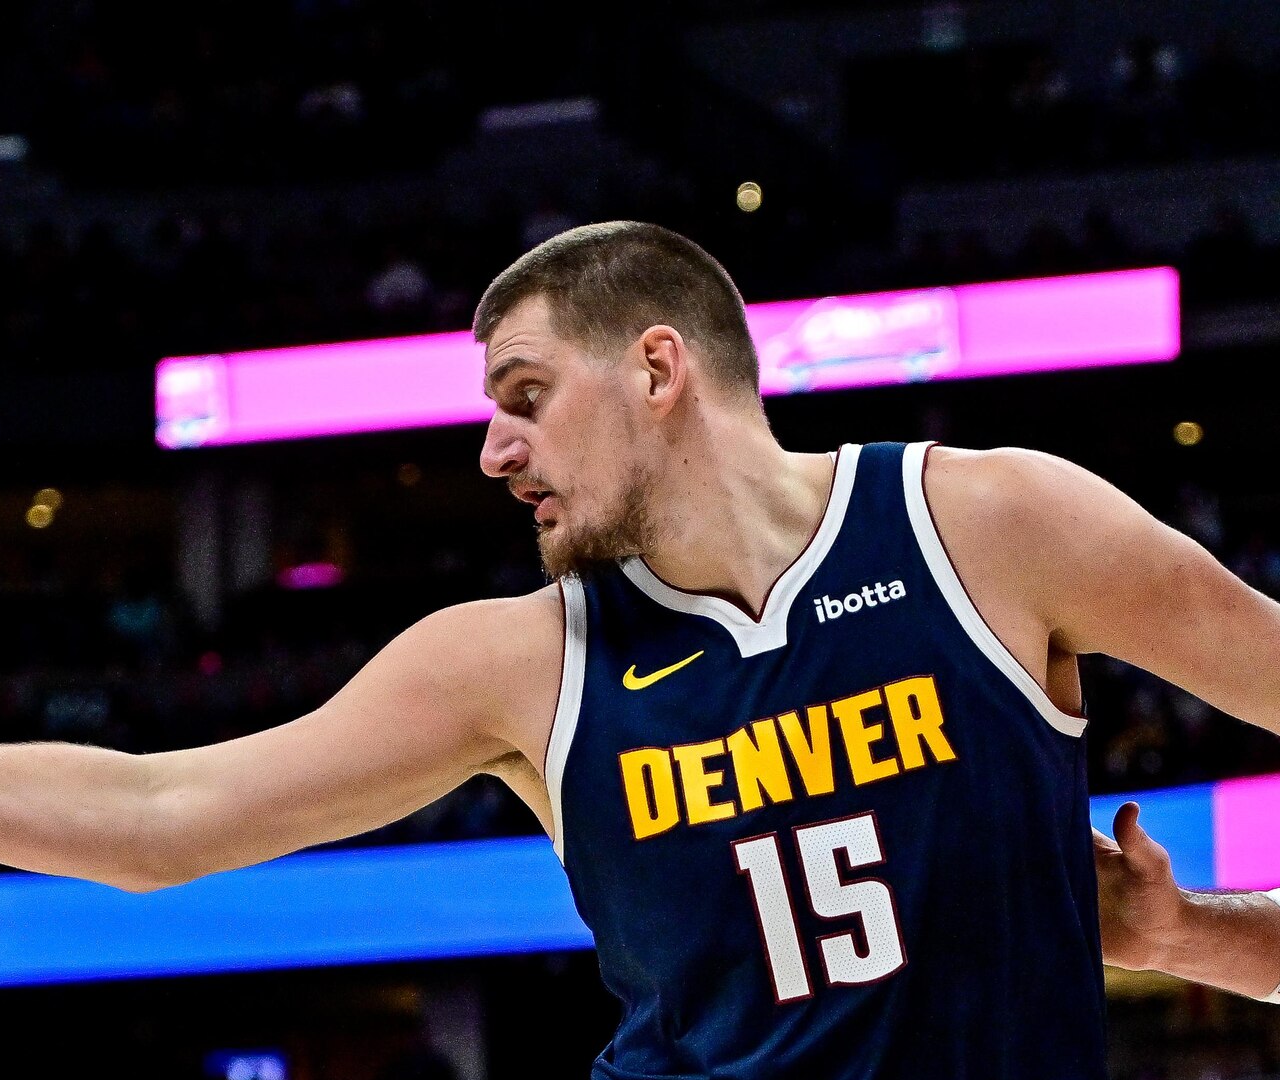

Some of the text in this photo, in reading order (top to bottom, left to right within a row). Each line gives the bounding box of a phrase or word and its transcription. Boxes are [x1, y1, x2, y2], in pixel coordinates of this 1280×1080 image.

[814, 579, 907, 623] ibotta
[618, 673, 958, 841] DENVER
[730, 810, 908, 1004] 15
